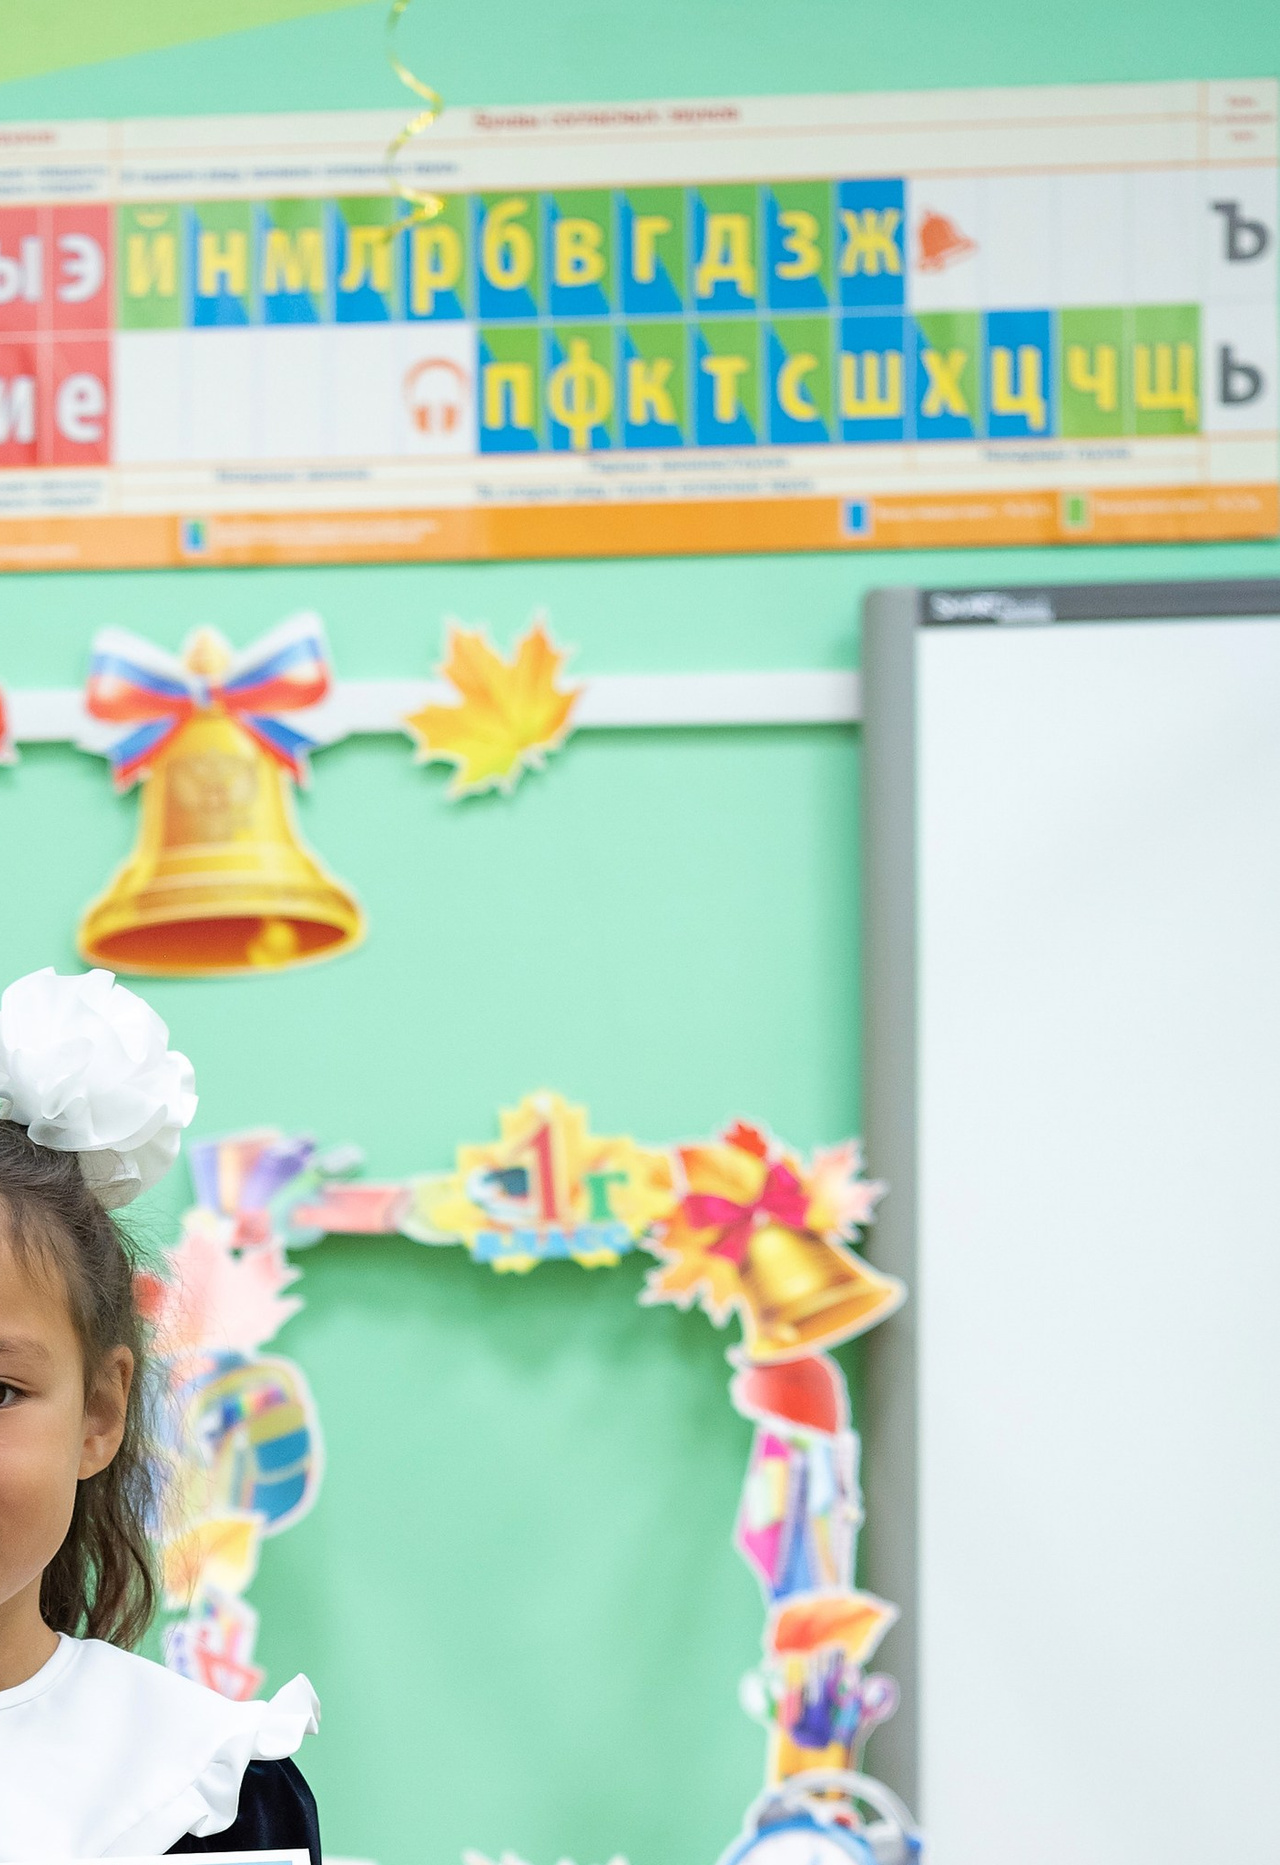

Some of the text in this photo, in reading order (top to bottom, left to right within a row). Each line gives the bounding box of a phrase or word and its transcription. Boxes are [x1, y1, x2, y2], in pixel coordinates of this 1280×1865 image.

[58, 233, 104, 302] э
[696, 213, 756, 297] д
[56, 373, 106, 442] е
